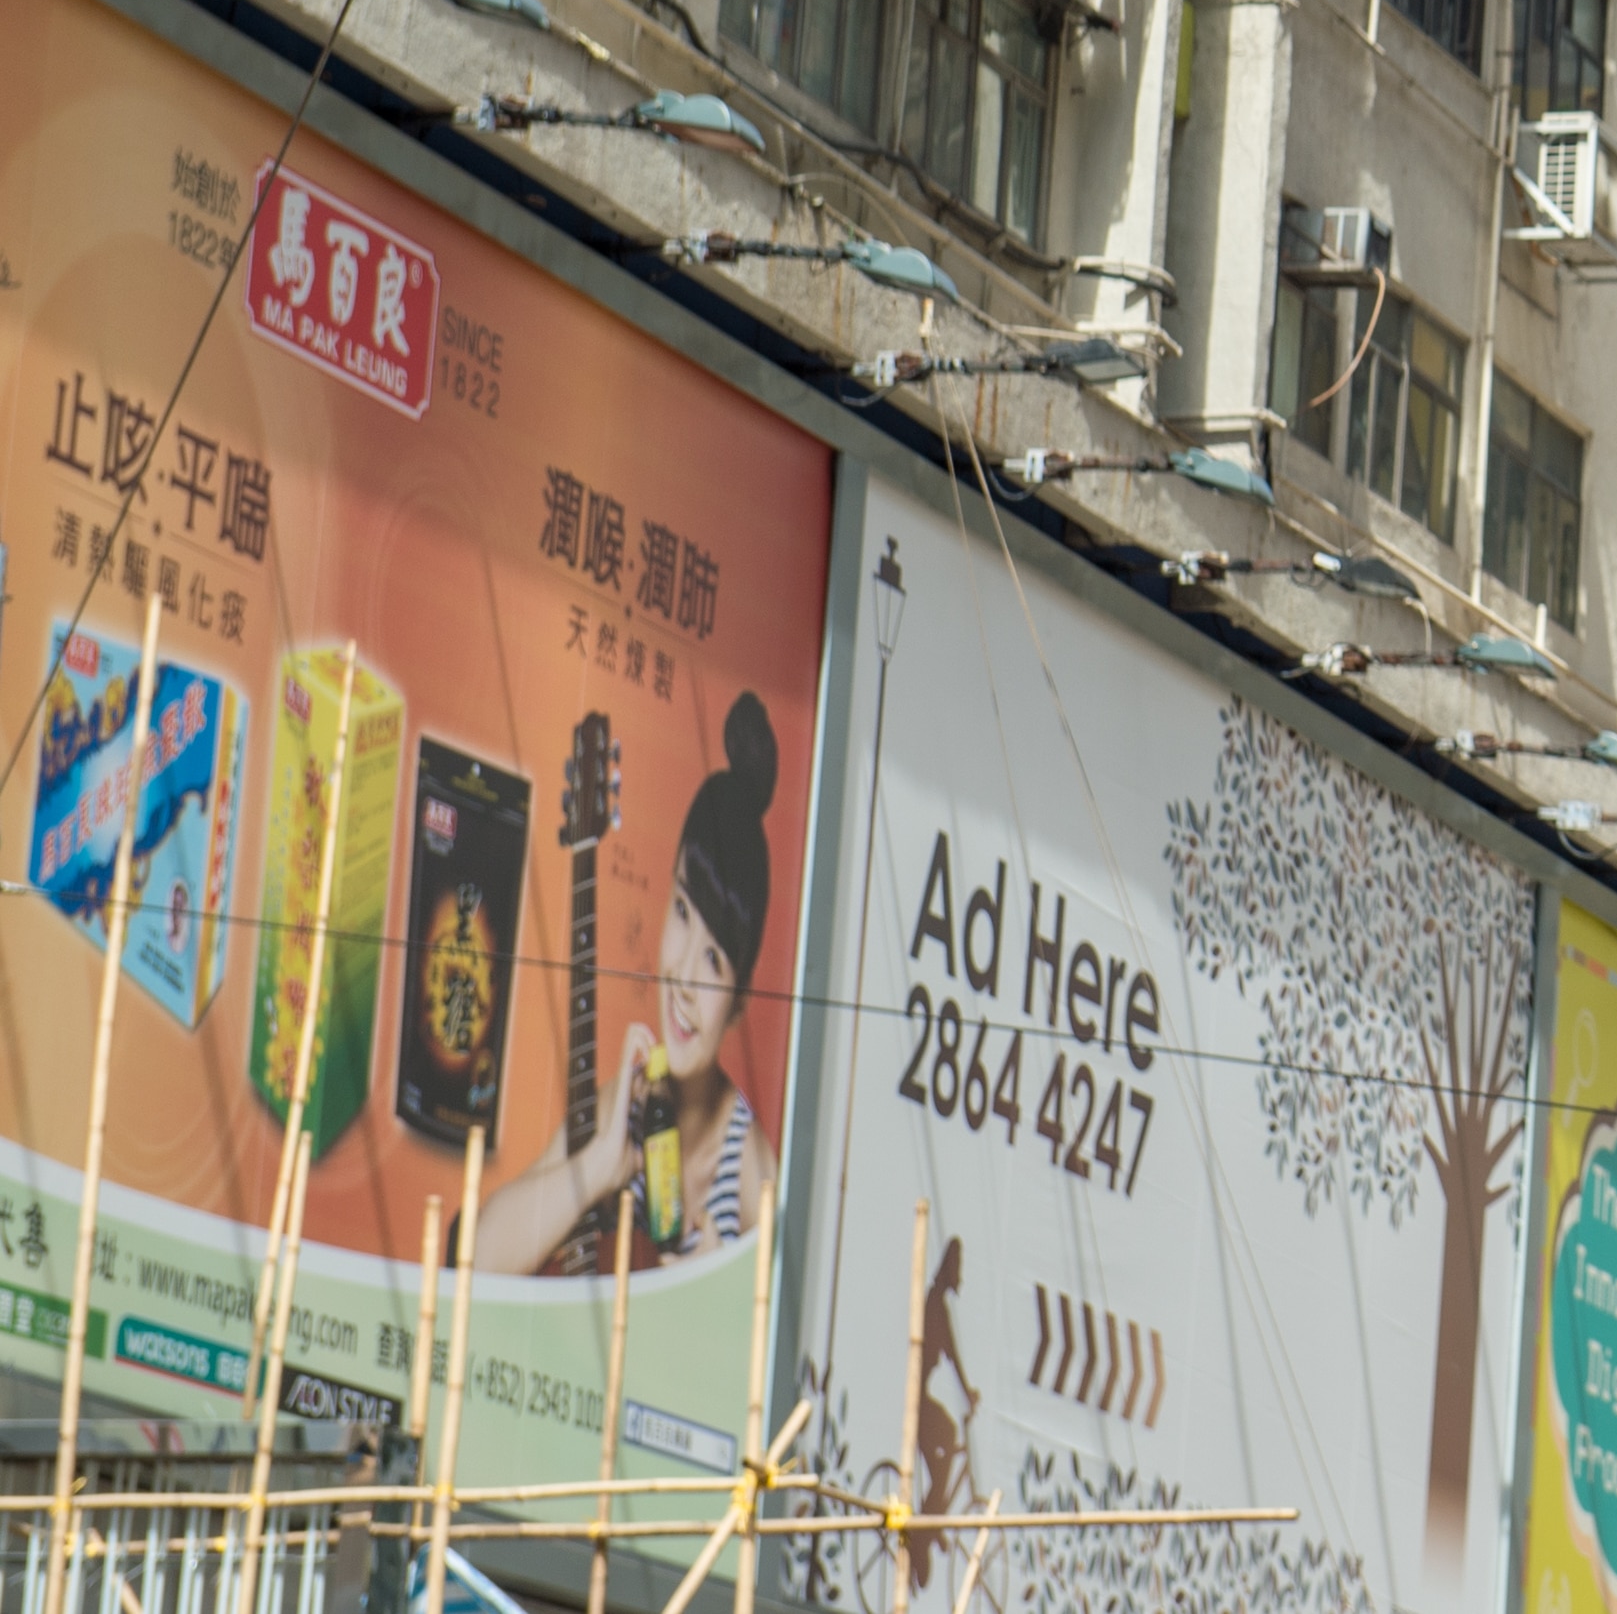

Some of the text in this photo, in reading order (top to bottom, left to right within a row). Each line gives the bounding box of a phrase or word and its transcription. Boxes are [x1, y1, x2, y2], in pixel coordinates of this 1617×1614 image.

[269, 185, 411, 357] 馬百良
[441, 304, 505, 374] SINCE
[262, 292, 409, 399] MA PAK LEUNG
[438, 353, 502, 420] 1822
[909, 830, 1160, 1072] Ad Here
[898, 984, 1156, 1200] 2864 4247
